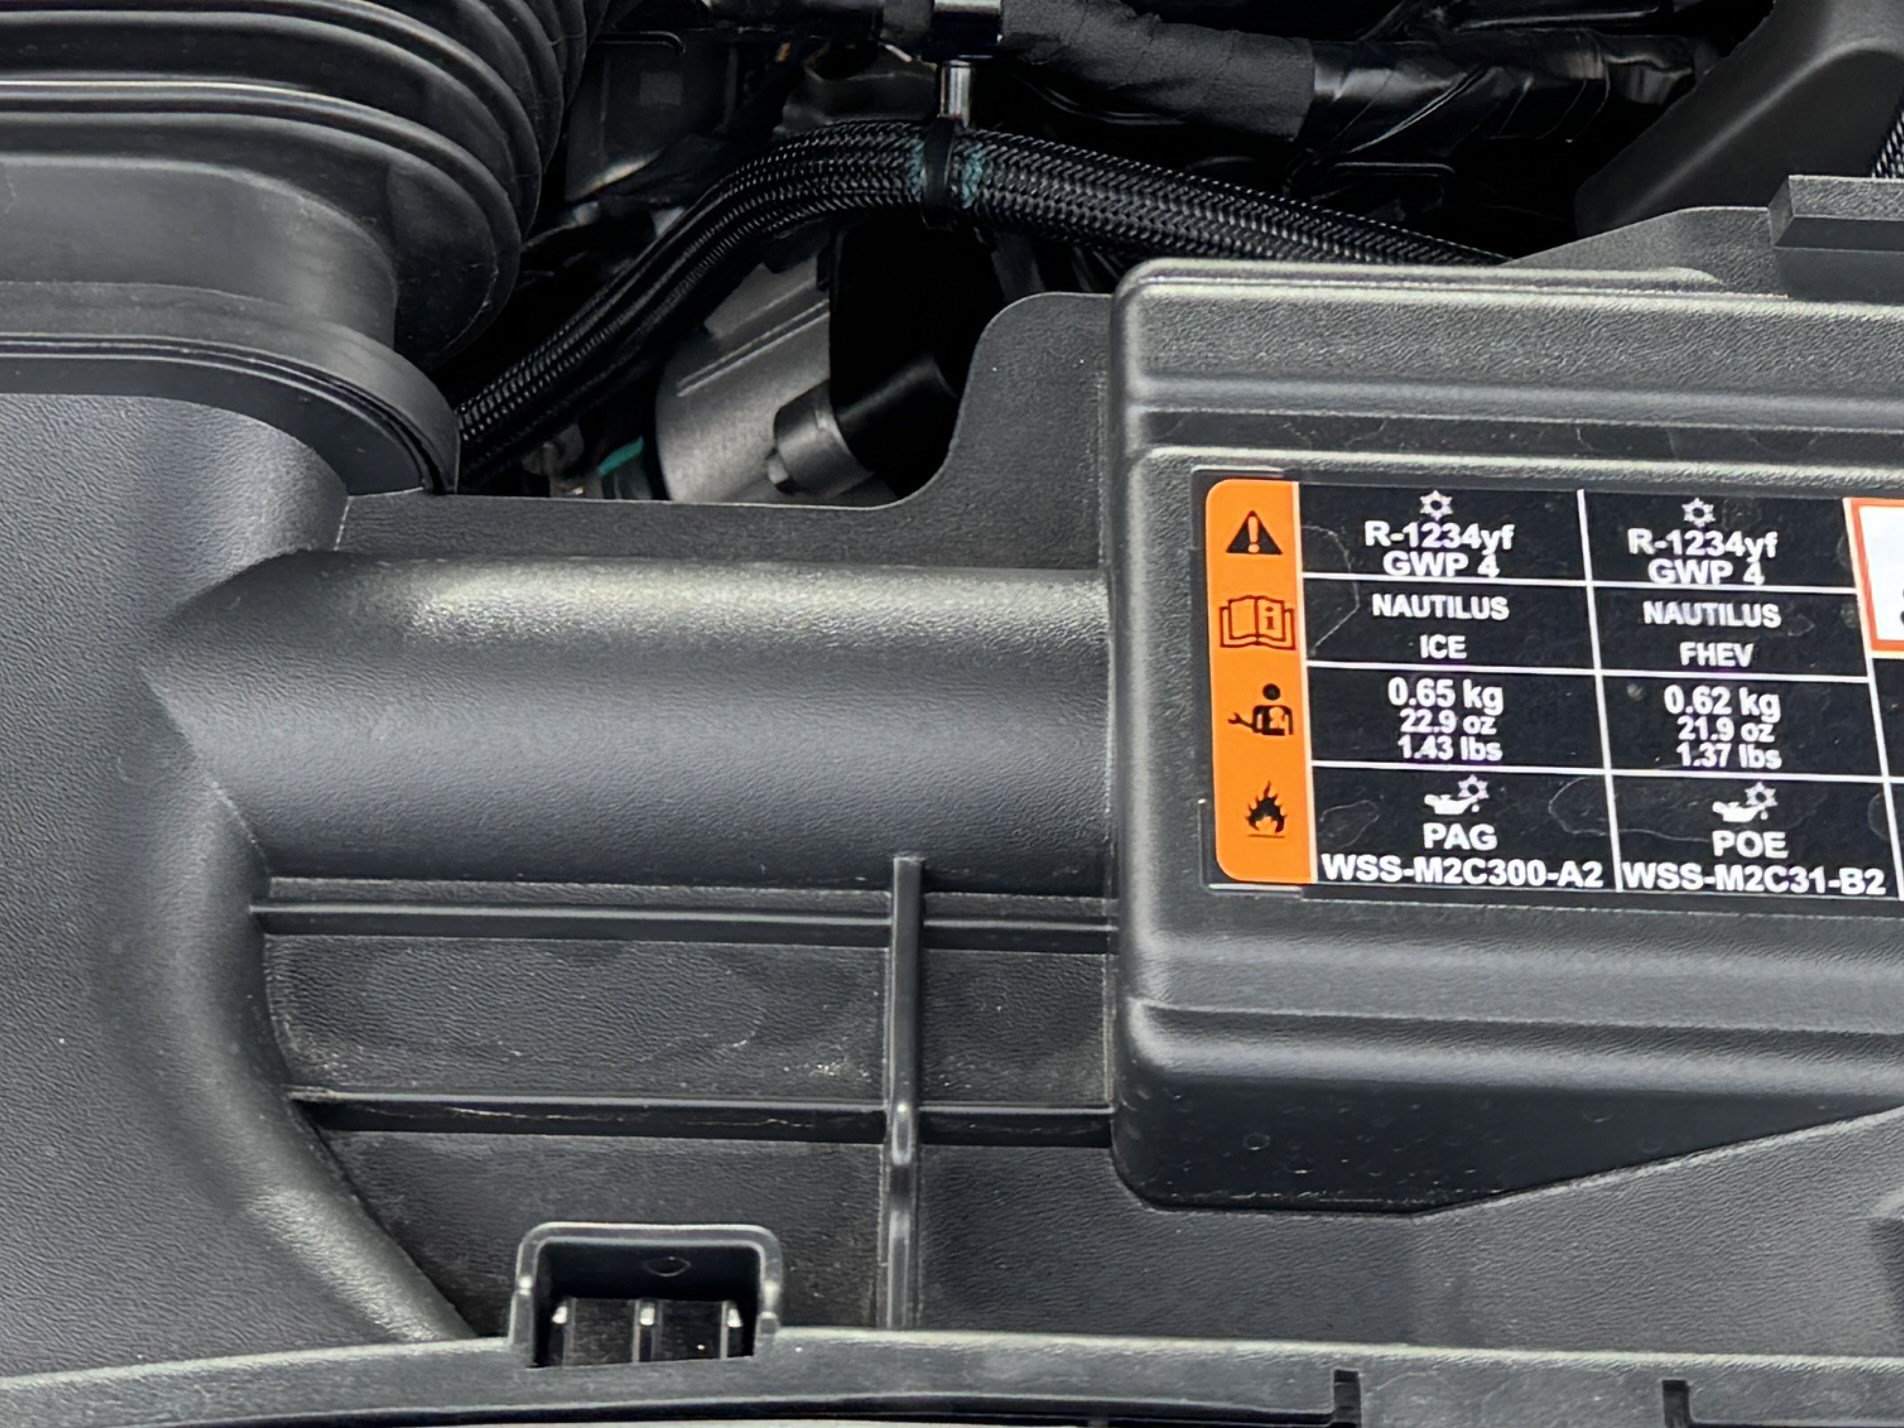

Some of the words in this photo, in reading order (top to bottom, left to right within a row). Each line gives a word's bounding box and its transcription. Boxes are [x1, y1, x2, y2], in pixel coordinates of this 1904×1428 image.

[1364, 519, 1515, 556] R-1234yf
[1627, 528, 1779, 563] R-1234yf
[1382, 550, 1469, 577] GWP
[1477, 554, 1501, 578] 4
[1648, 558, 1734, 585] GWP
[1743, 561, 1766, 586] 4
[1372, 593, 1510, 621] NAUTILUS
[1643, 600, 1782, 628] NAUTILUS
[1419, 634, 1468, 660] ICE
[1679, 641, 1755, 667] FHEV
[1388, 677, 1456, 706] 0.65
[1462, 679, 1504, 716] kg
[1663, 684, 1732, 715] 0.62
[1739, 687, 1781, 723] kg
[1399, 708, 1457, 734] 22.9
[1462, 715, 1497, 736] oz
[1677, 716, 1735, 741] 21.9
[1741, 723, 1775, 742] oz
[1397, 734, 1454, 760] 1.43
[1460, 736, 1503, 761] lbs
[1675, 742, 1733, 767] 1.37
[1738, 744, 1783, 770] lbs
[1423, 822, 1498, 851] PAG
[1712, 830, 1789, 859] POE
[1321, 853, 1604, 888] WSS-M2C300-A2
[1622, 861, 1886, 895] WSS-M2C31-B2
